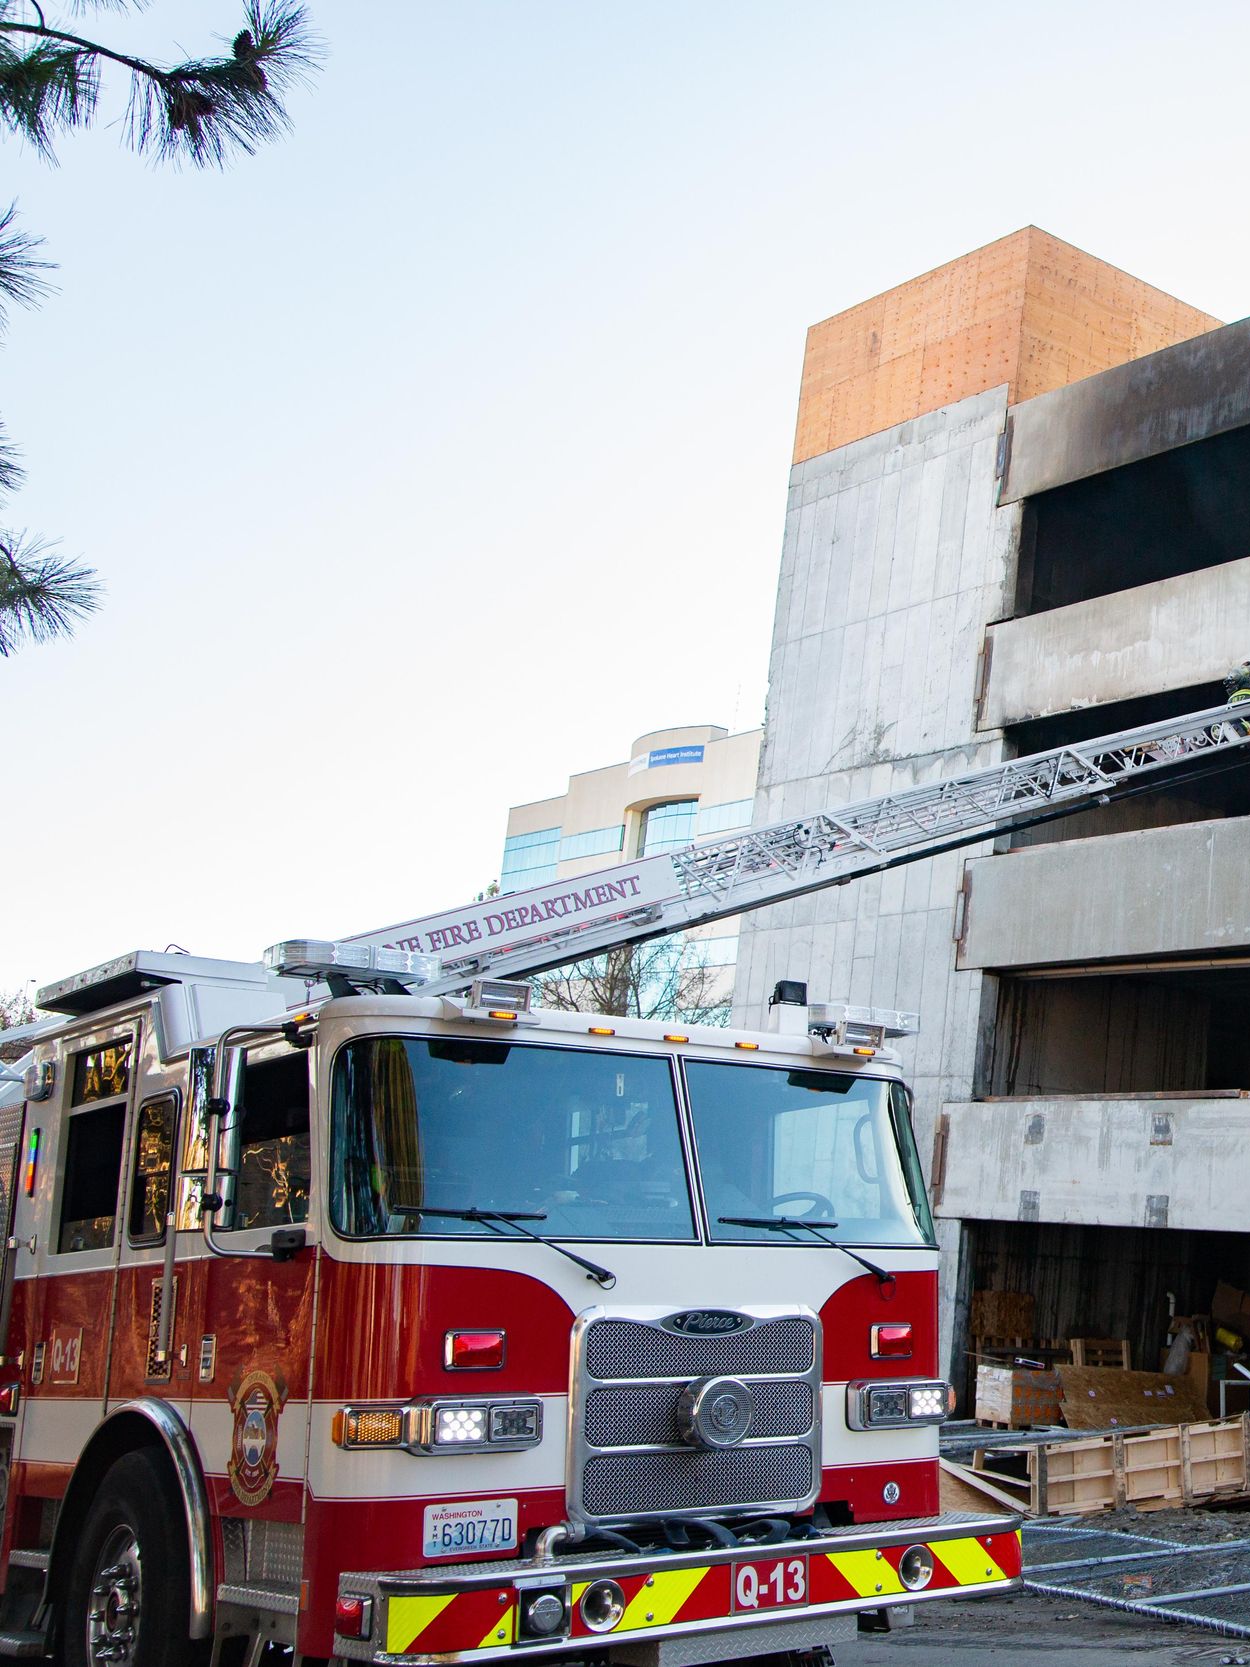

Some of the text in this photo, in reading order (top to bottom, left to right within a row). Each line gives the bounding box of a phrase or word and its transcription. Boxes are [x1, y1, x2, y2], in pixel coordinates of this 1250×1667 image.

[680, 750, 702, 758] Institute
[425, 920, 482, 952] FIRE
[483, 875, 641, 936] DEPARTMENT
[683, 1312, 735, 1332] Pierce
[53, 1338, 80, 1374] Q-13
[432, 1510, 483, 1521] WASHINGTON
[442, 1517, 512, 1547] 63077D
[737, 1560, 805, 1608] Q-13
